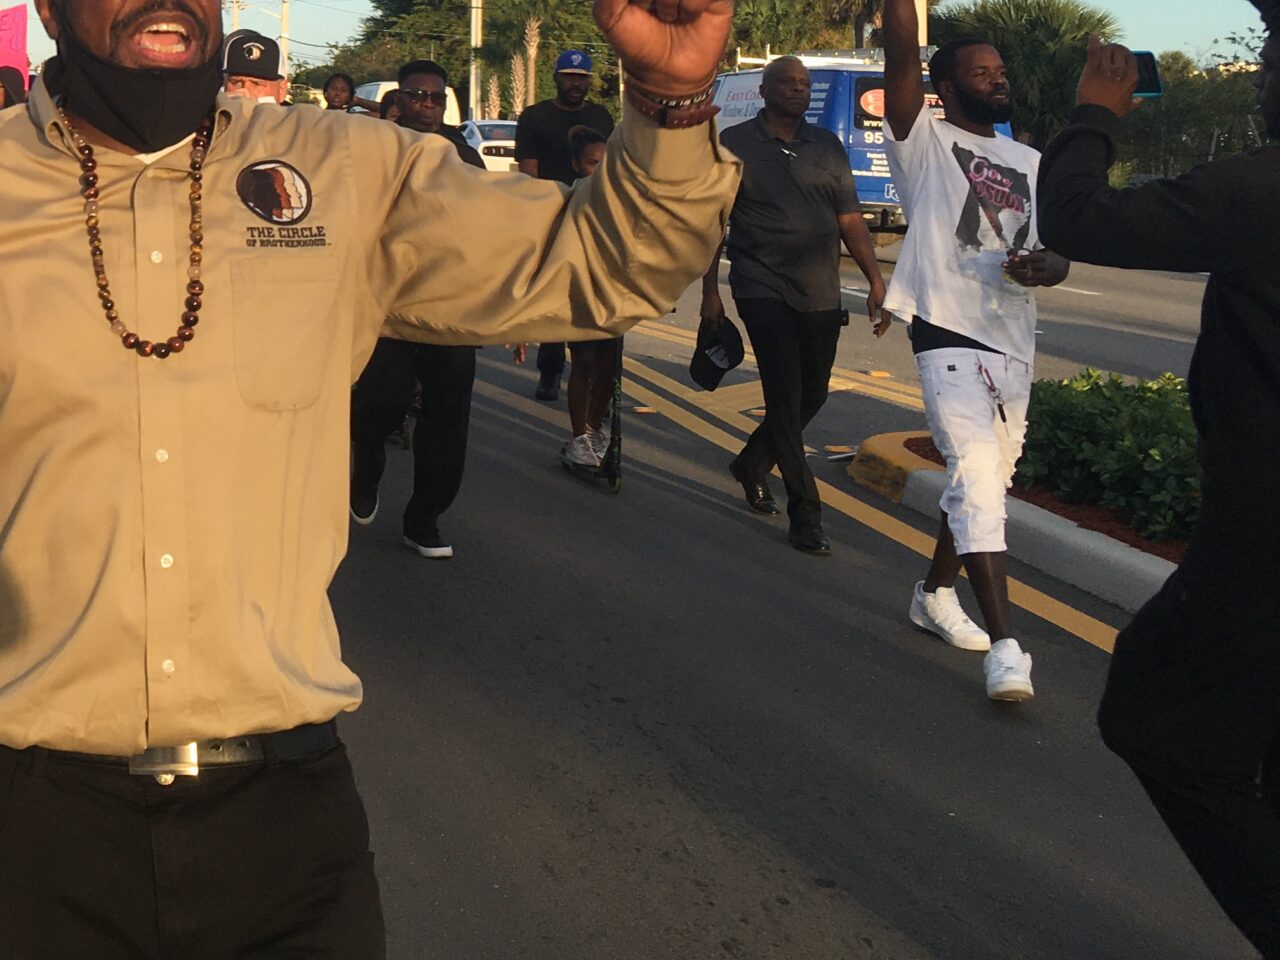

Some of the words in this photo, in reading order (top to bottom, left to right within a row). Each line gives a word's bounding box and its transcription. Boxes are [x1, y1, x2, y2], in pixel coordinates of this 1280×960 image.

[246, 226, 275, 238] THE
[278, 226, 326, 239] CIRCLE
[246, 239, 257, 247] OF
